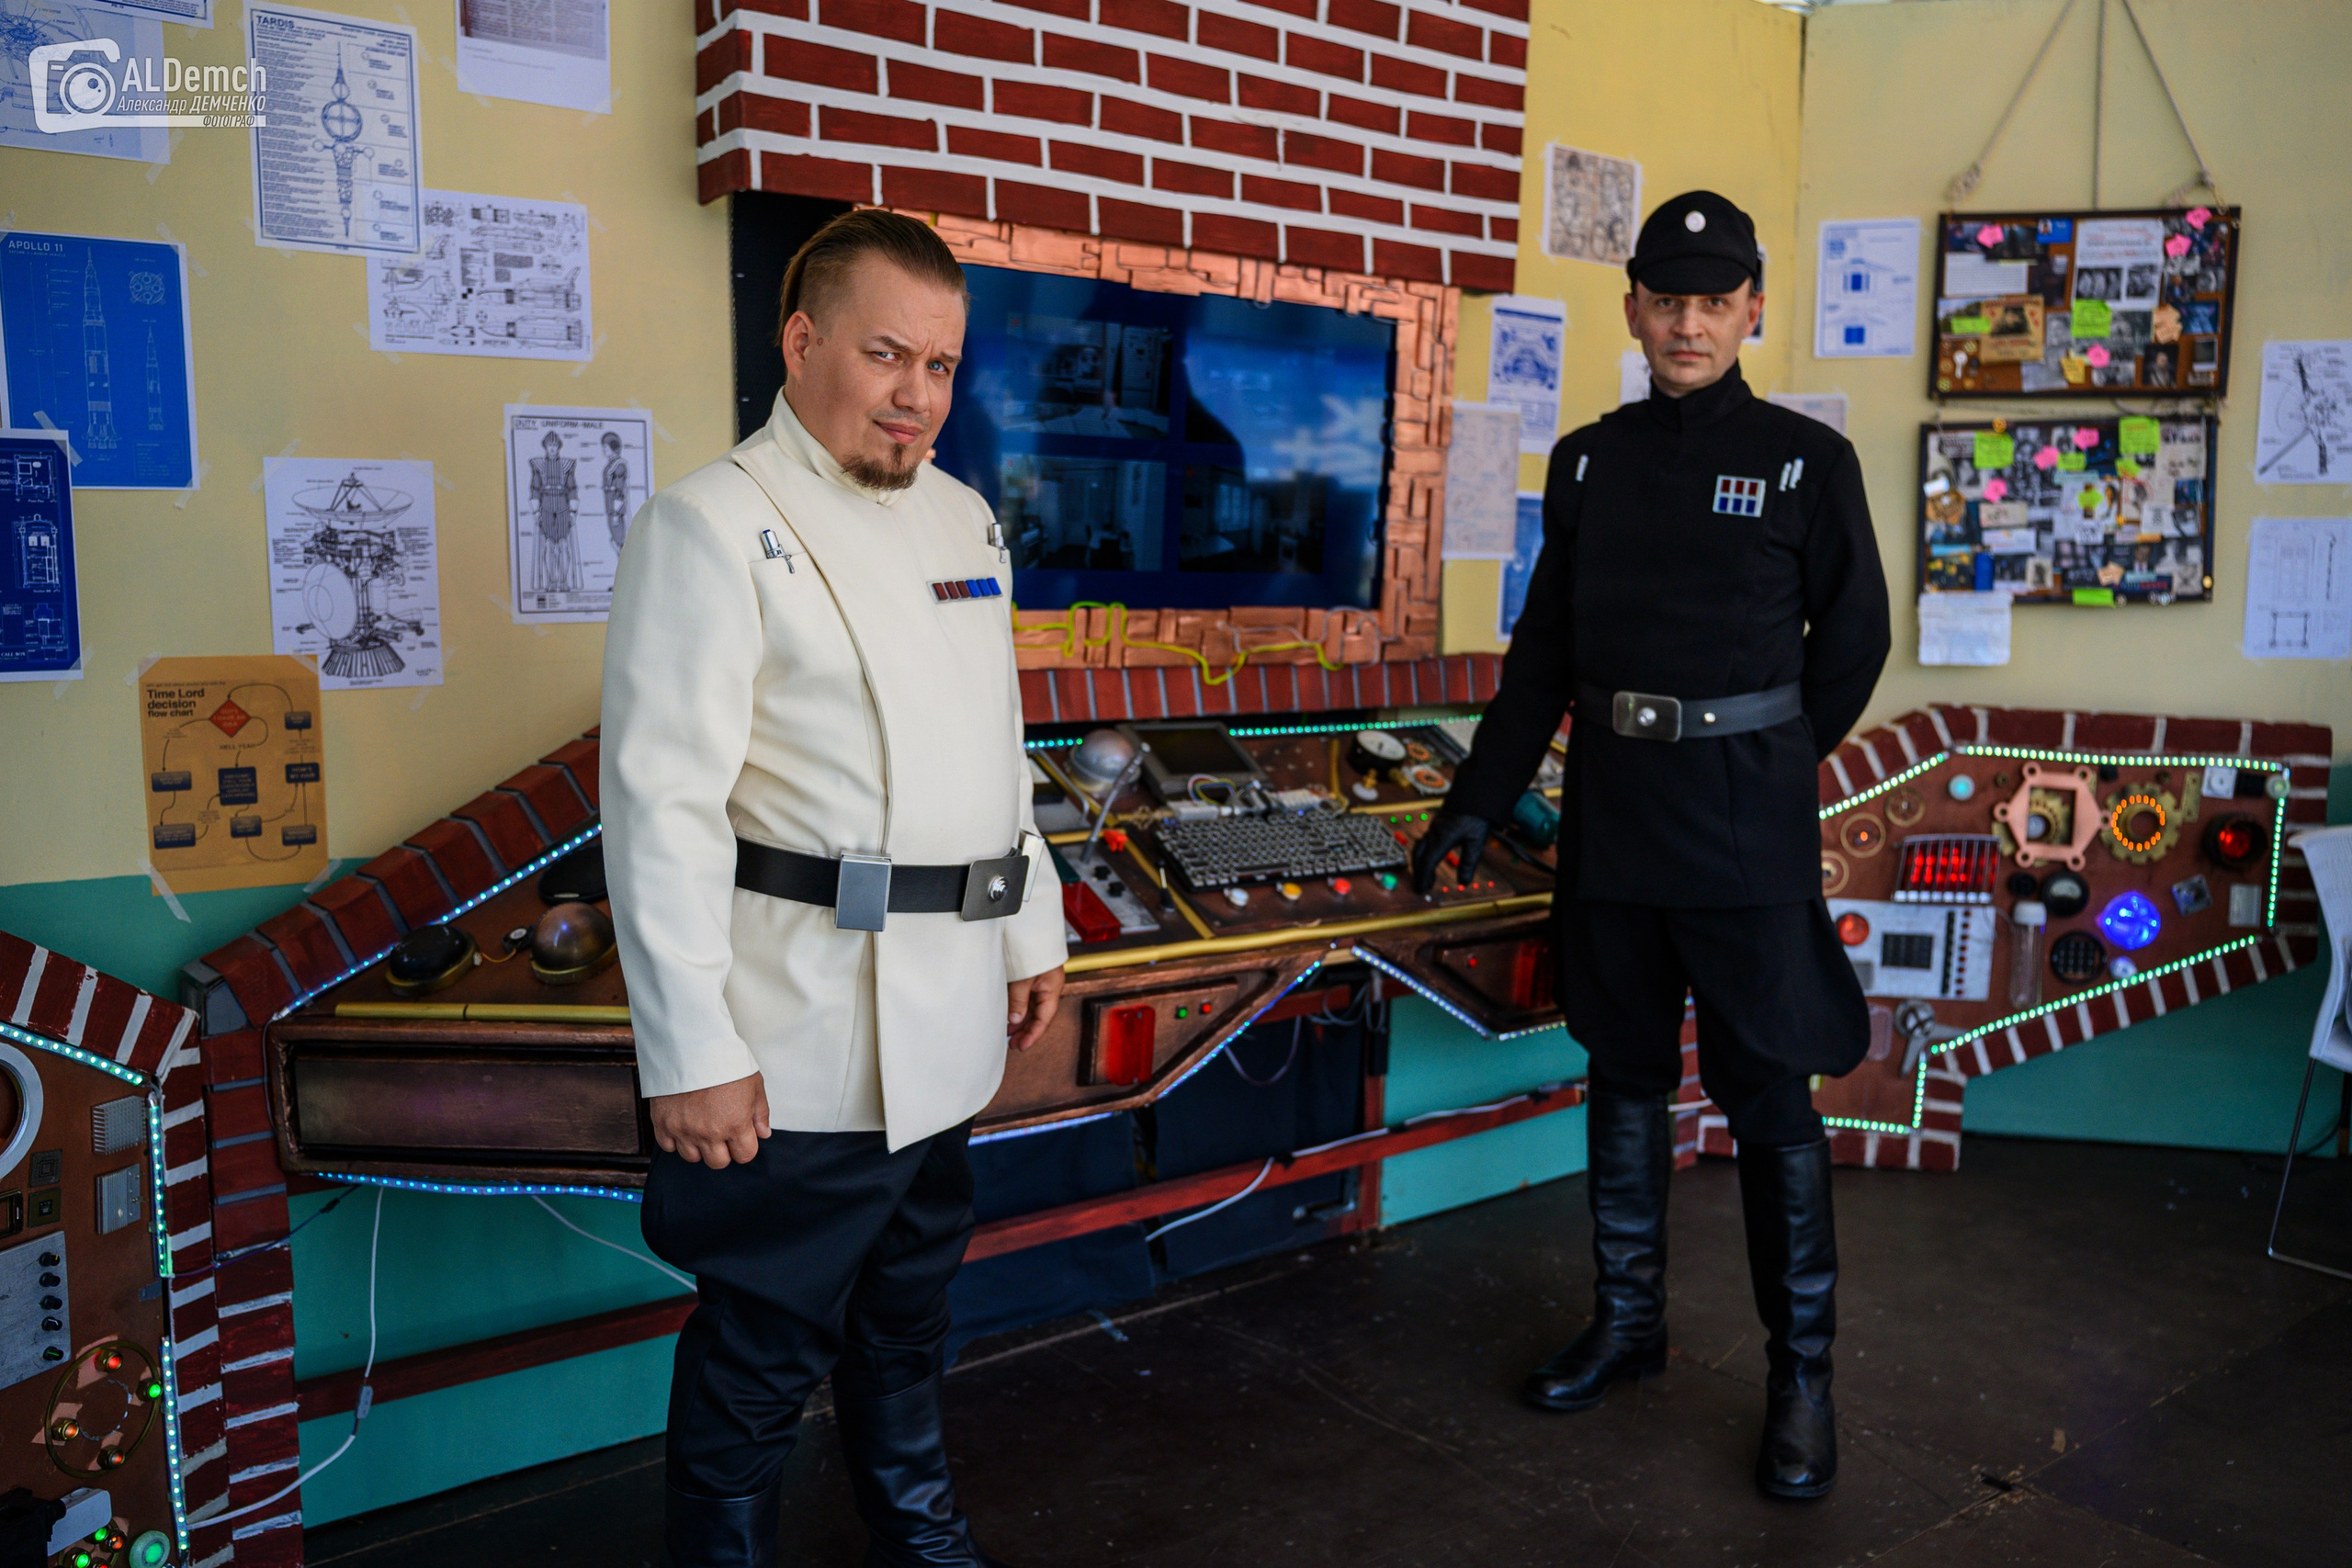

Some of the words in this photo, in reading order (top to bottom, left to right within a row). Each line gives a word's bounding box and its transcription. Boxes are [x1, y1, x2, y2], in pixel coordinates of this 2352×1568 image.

[256, 15, 295, 28] TARDIS
[8, 240, 51, 252] APOLLO
[54, 243, 63, 252] 11
[147, 689, 175, 699] Time
[178, 688, 205, 698] Lord
[147, 699, 197, 709] decision
